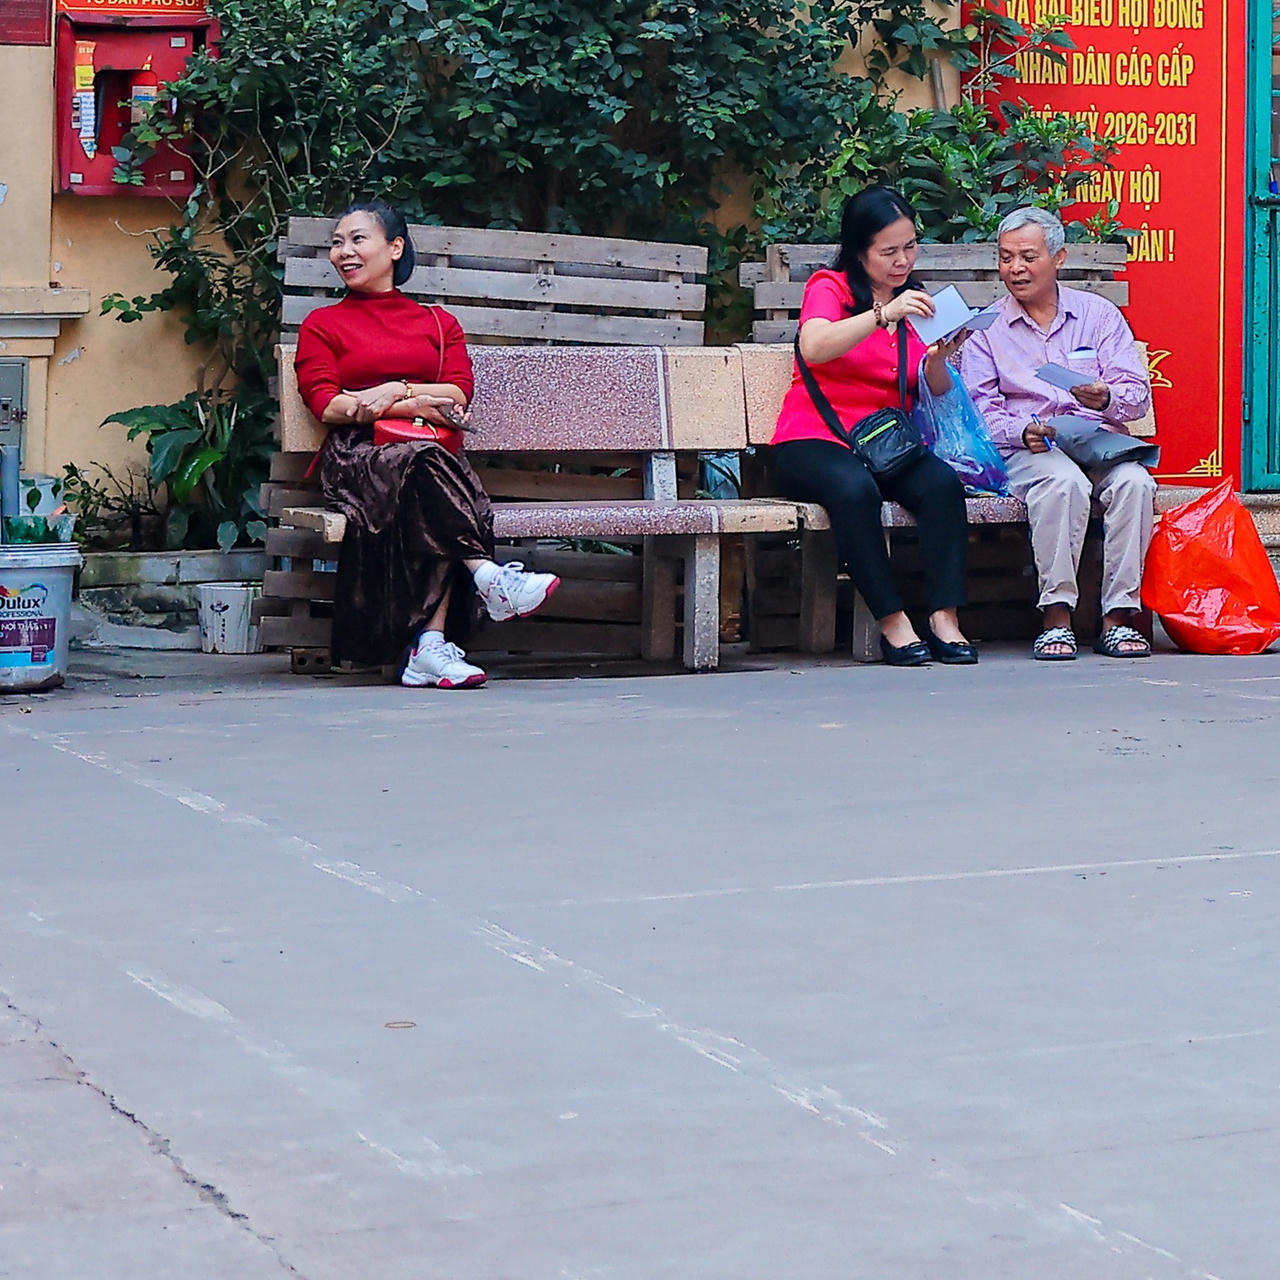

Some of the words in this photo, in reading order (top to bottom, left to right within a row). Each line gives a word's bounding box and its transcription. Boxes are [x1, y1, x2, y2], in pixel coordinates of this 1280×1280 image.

[1015, 45, 1067, 85] NHÂN
[1073, 45, 1111, 86] DÂN
[1116, 46, 1153, 87] CÁC
[1158, 42, 1195, 87] CẤP
[1104, 112, 1197, 145] 2026-2031
[1129, 163, 1161, 211] HỘI
